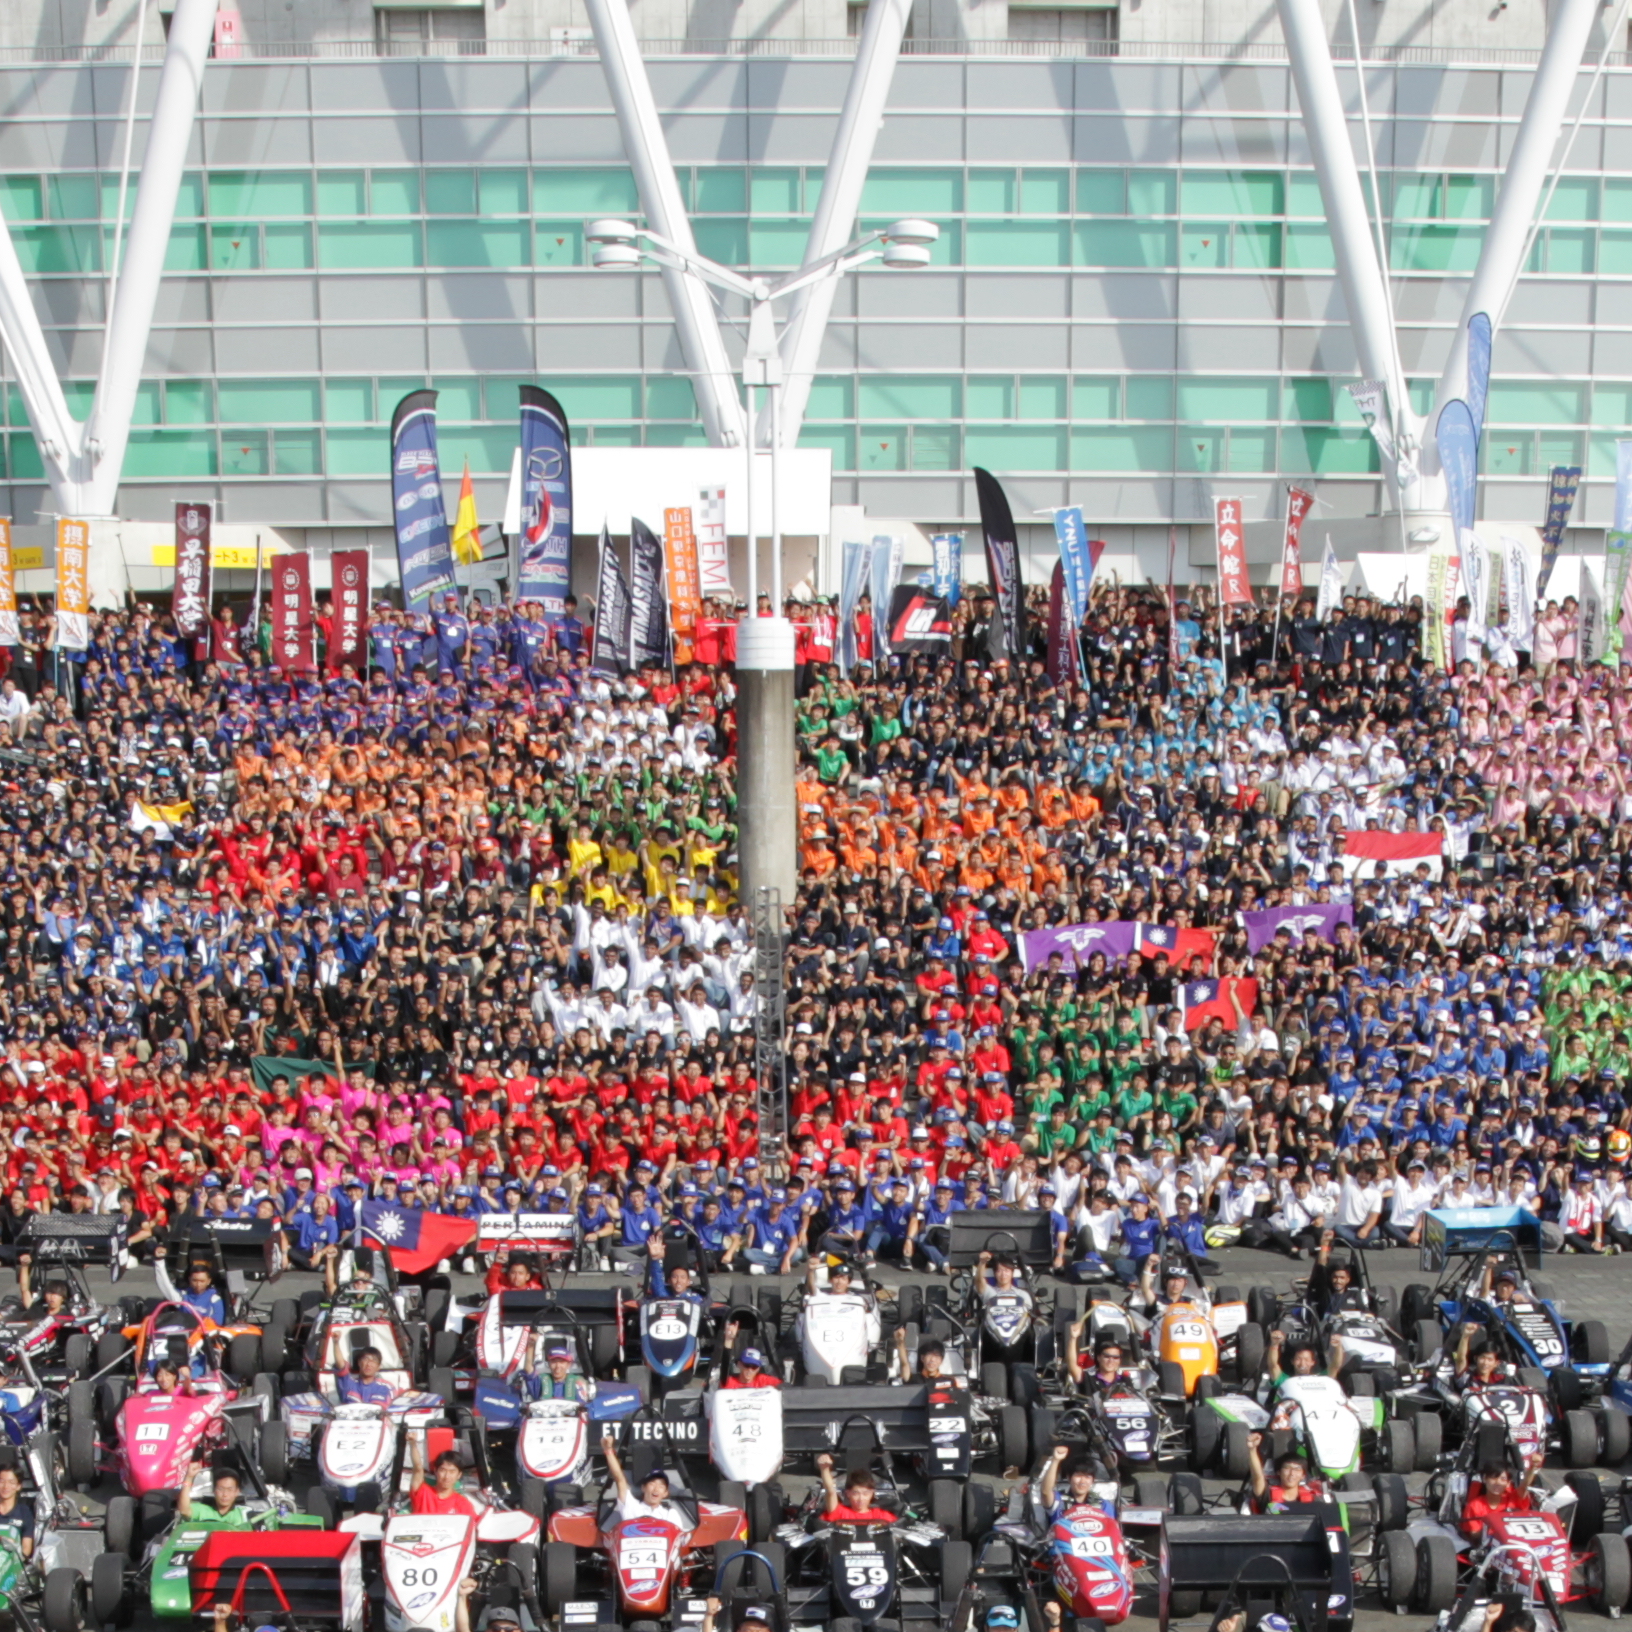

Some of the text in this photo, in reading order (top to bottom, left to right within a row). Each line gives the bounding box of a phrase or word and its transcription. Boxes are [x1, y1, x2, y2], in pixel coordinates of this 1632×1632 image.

[700, 522, 727, 584] FEM
[62, 524, 85, 608] 摂南大学
[283, 593, 300, 659] 明星大学
[342, 590, 359, 655] 明星大学
[654, 1323, 681, 1336] E13
[823, 1327, 845, 1344] E3
[1172, 1324, 1203, 1337] 49
[1533, 1338, 1563, 1356] 30
[1501, 1400, 1518, 1417] 2
[140, 1423, 164, 1440] 11
[632, 1421, 699, 1440] TECHNO
[731, 1423, 763, 1438] 48
[930, 1417, 966, 1433] 22
[1115, 1417, 1146, 1430] 56
[336, 1440, 366, 1451] E2
[1514, 1520, 1548, 1538] 13
[1076, 1538, 1107, 1556] 40
[627, 1550, 659, 1565] 54
[402, 1566, 438, 1588] 80
[846, 1567, 889, 1586] 59
